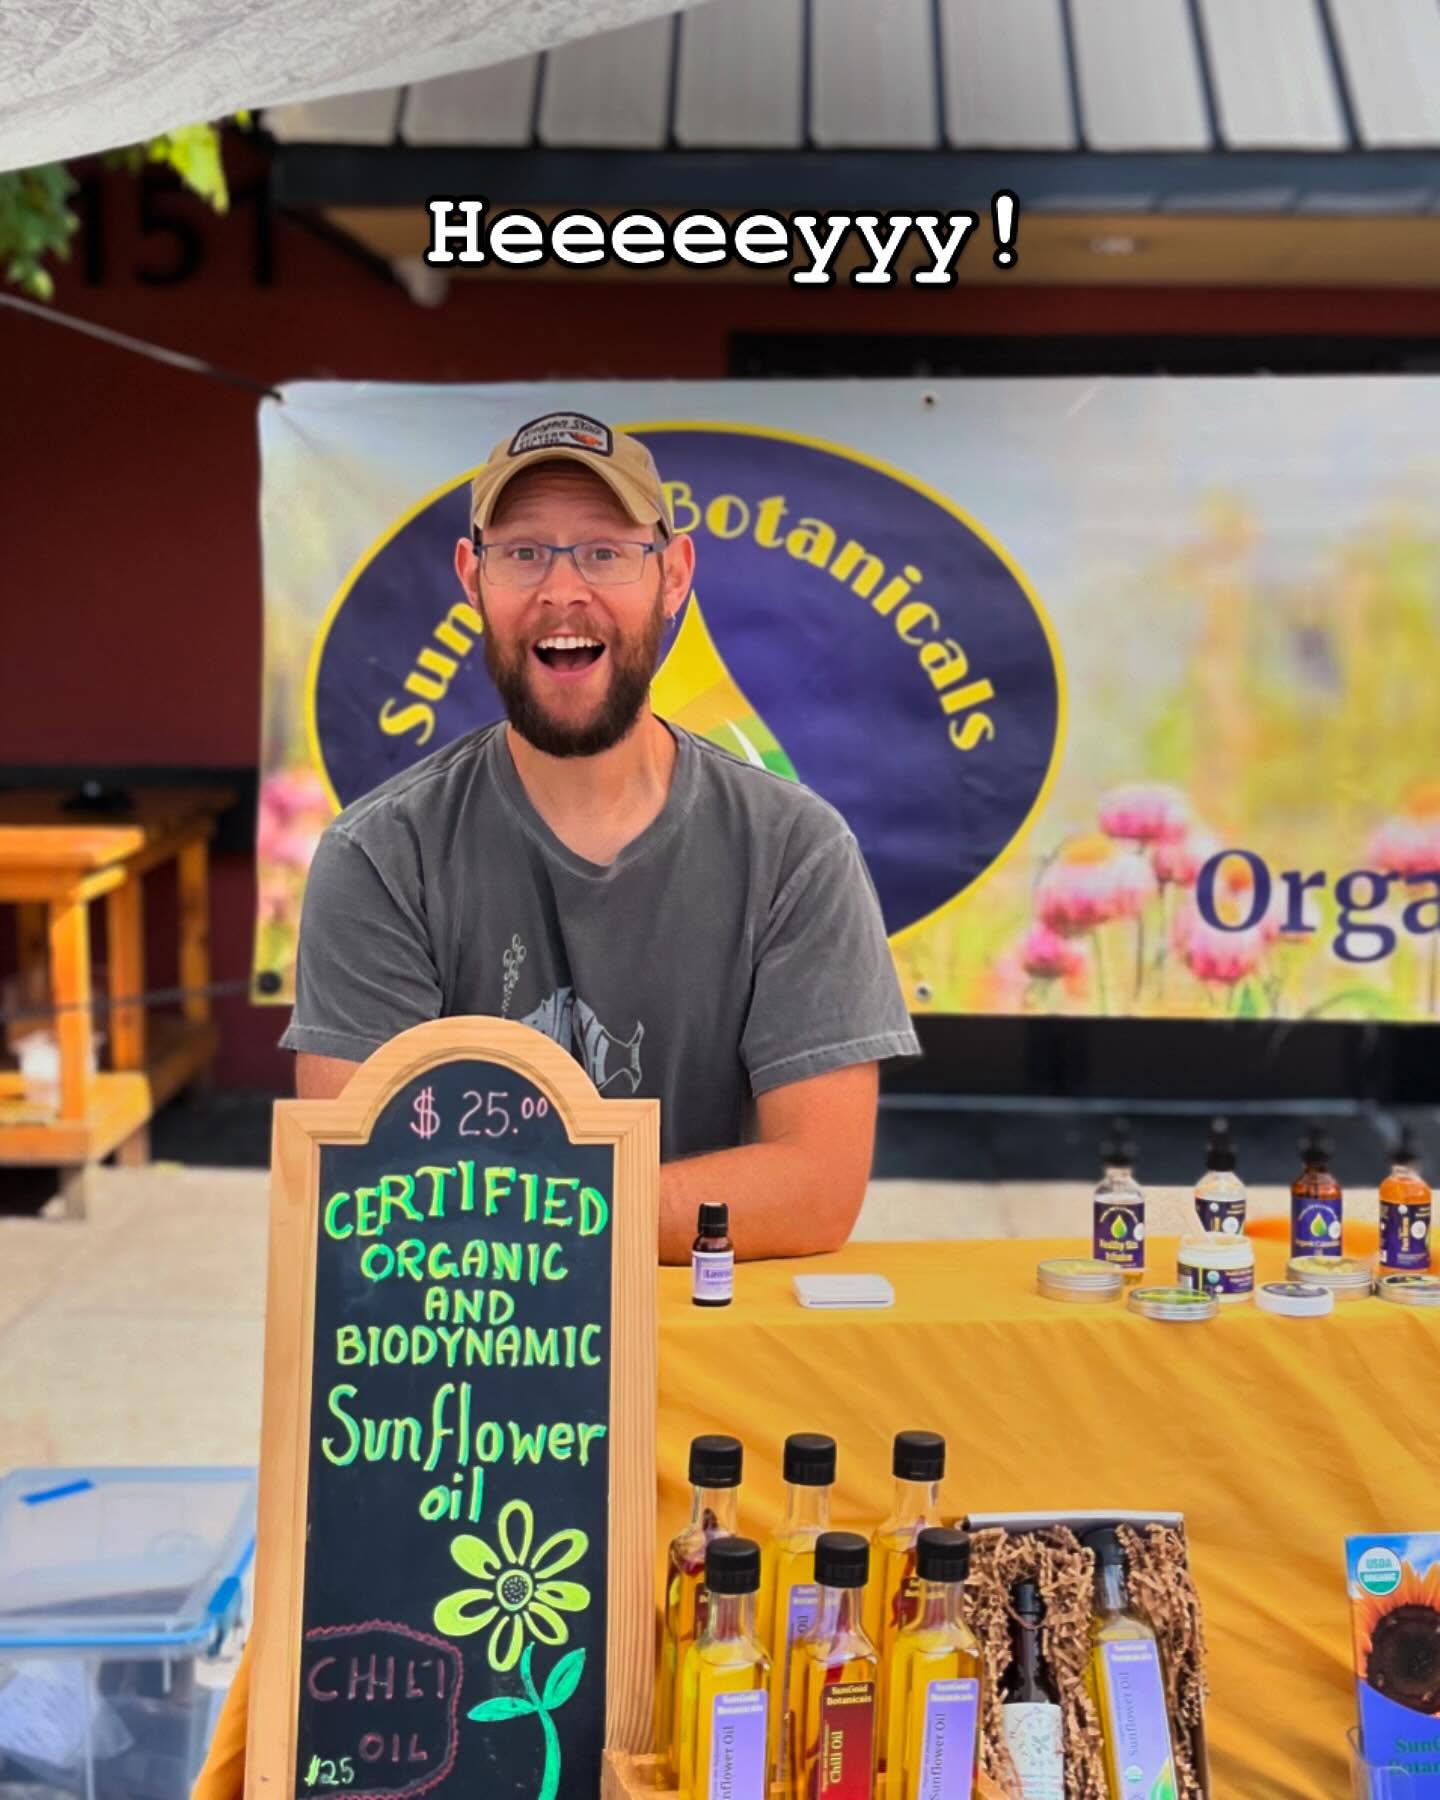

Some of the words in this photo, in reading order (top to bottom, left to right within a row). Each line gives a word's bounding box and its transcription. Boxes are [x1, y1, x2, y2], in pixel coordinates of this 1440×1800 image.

[661, 480, 996, 753] Botanicals
[1196, 849, 1440, 963] Orga
[324, 1160, 609, 1240] CERTIFIED
[360, 1238, 569, 1285] ORGANIC
[425, 1286, 515, 1325] AND
[336, 1324, 602, 1367] BIODYNAMIC
[321, 1381, 608, 1471] Sunflower
[419, 1466, 485, 1523] oil
[358, 1733, 428, 1762] OIL
[935, 1712, 946, 1731] Oil
